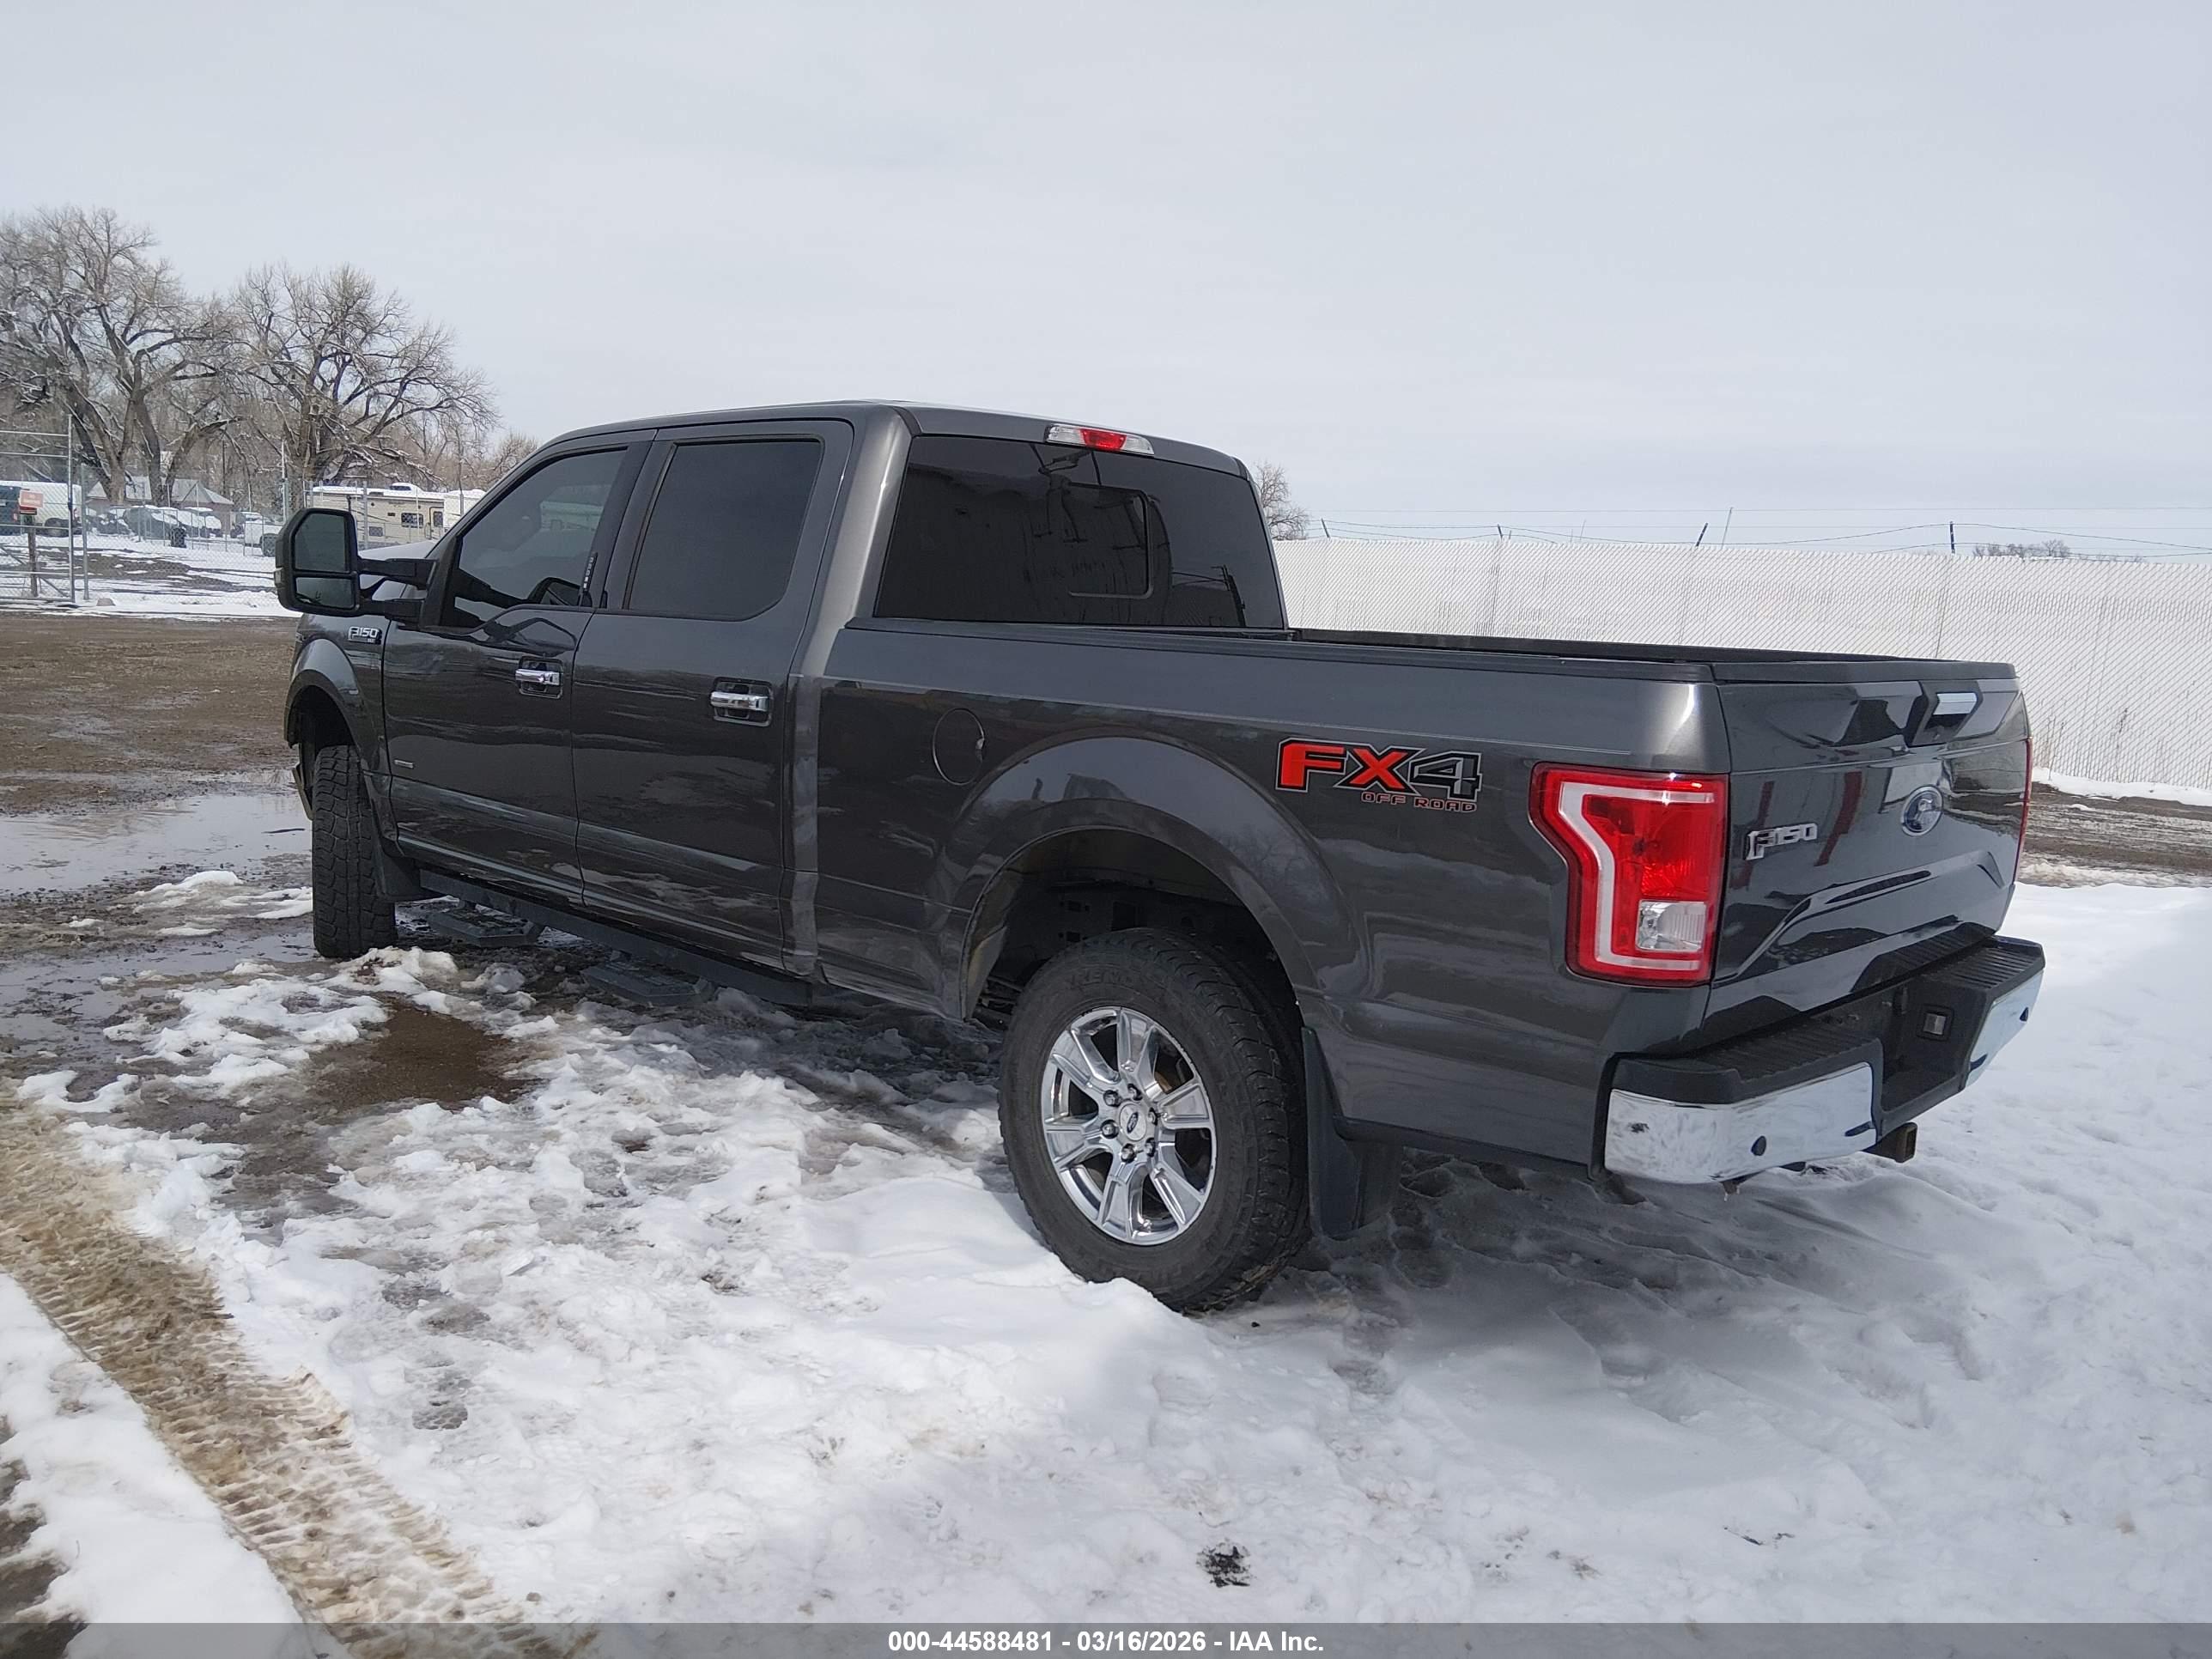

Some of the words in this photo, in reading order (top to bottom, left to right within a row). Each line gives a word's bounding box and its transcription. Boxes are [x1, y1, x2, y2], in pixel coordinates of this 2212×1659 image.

[1275, 737, 1483, 802] FX4
[1360, 791, 1407, 805] OFF
[1413, 797, 1478, 813] ROAD
